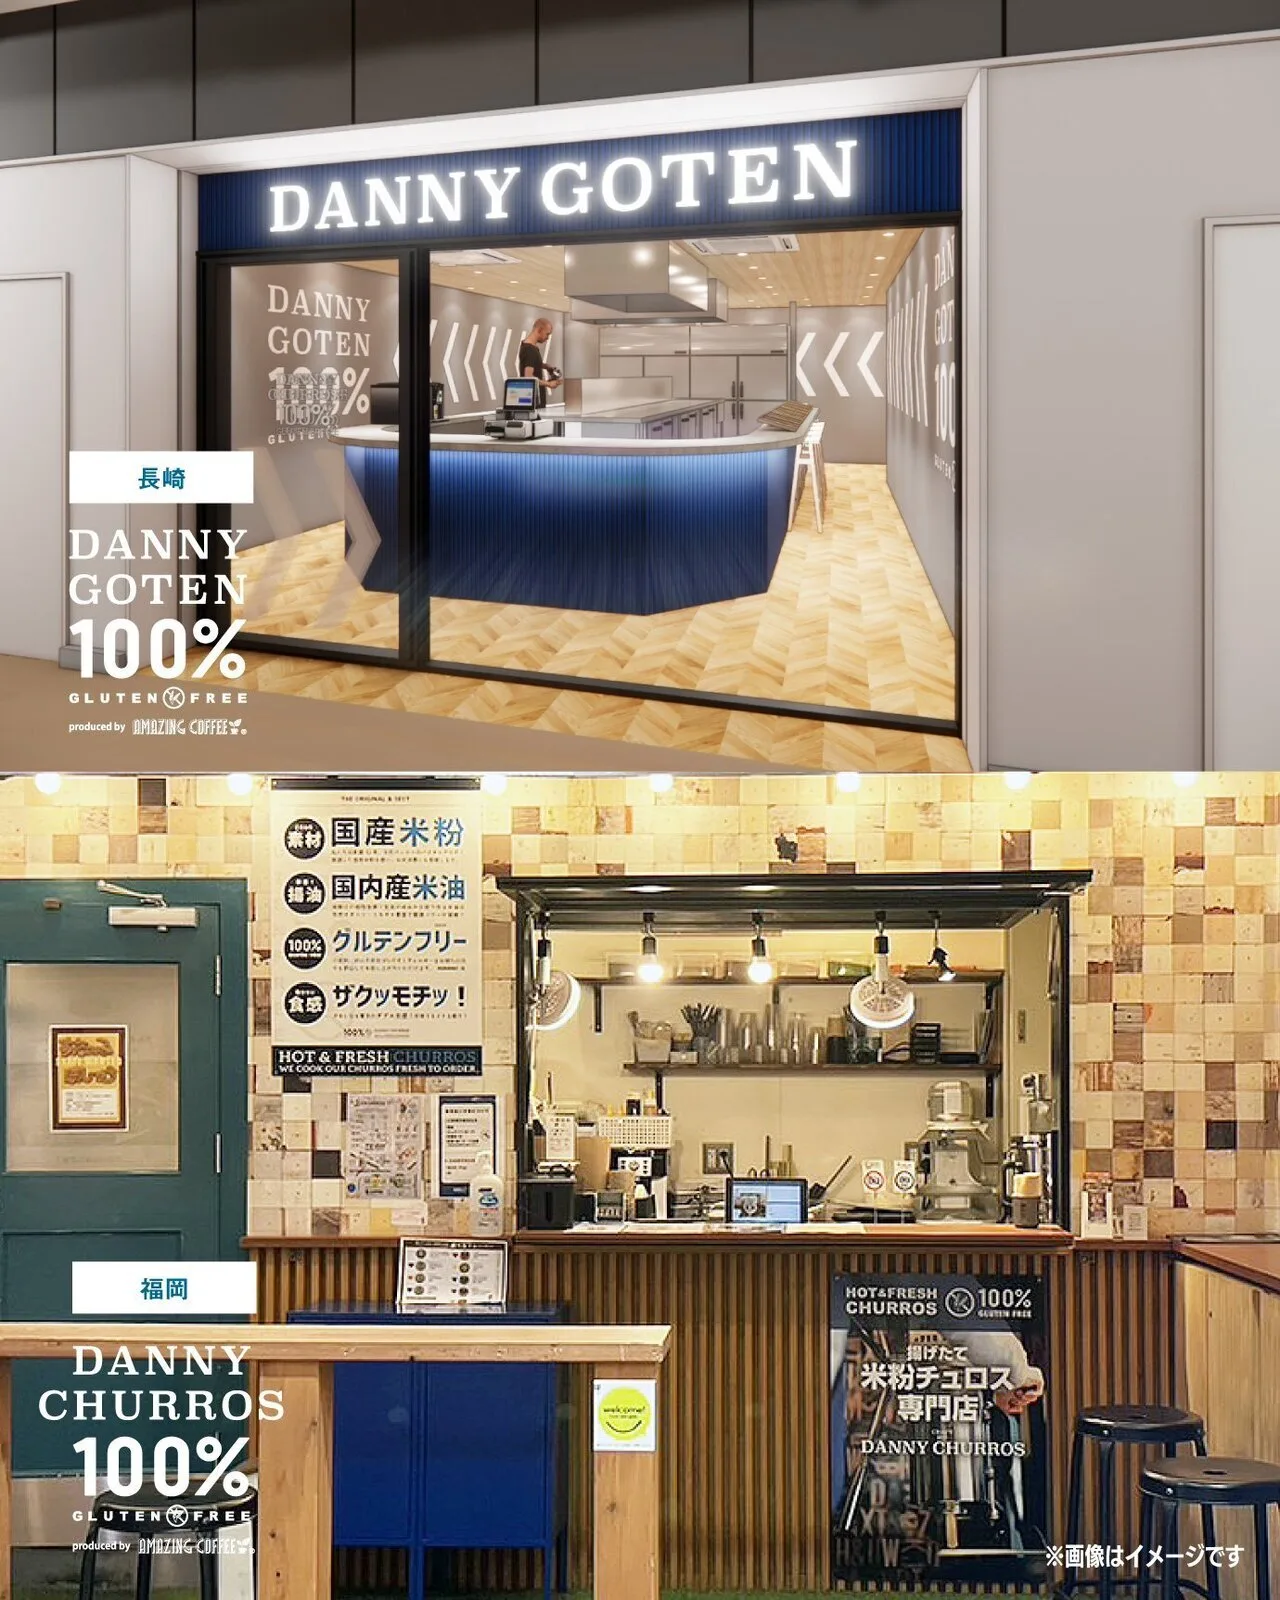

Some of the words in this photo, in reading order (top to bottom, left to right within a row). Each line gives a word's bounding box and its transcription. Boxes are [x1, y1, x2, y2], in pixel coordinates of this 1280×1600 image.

[269, 167, 521, 233] DANNY
[540, 140, 858, 215] GOTEN
[267, 284, 371, 323] DANNY
[267, 326, 371, 357] GOTEN
[331, 816, 464, 847] 国産米粉
[331, 873, 466, 900] 国内産米油
[287, 938, 322, 953] 100%
[333, 929, 468, 953] グルテンフリー
[279, 1050, 317, 1063] HOT
[318, 1050, 331, 1063] &
[335, 1050, 390, 1063] FRESH
[394, 1050, 477, 1064] CHURROS
[846, 1287, 938, 1299] HOT&FRESH
[977, 1288, 1032, 1308] 100%
[846, 1301, 938, 1316] CHURROS
[860, 1364, 1014, 1391] 米粉チュロス
[898, 1395, 980, 1422] 専門店
[861, 1440, 929, 1455] DANNY
[932, 1440, 1027, 1457] CHURROS
